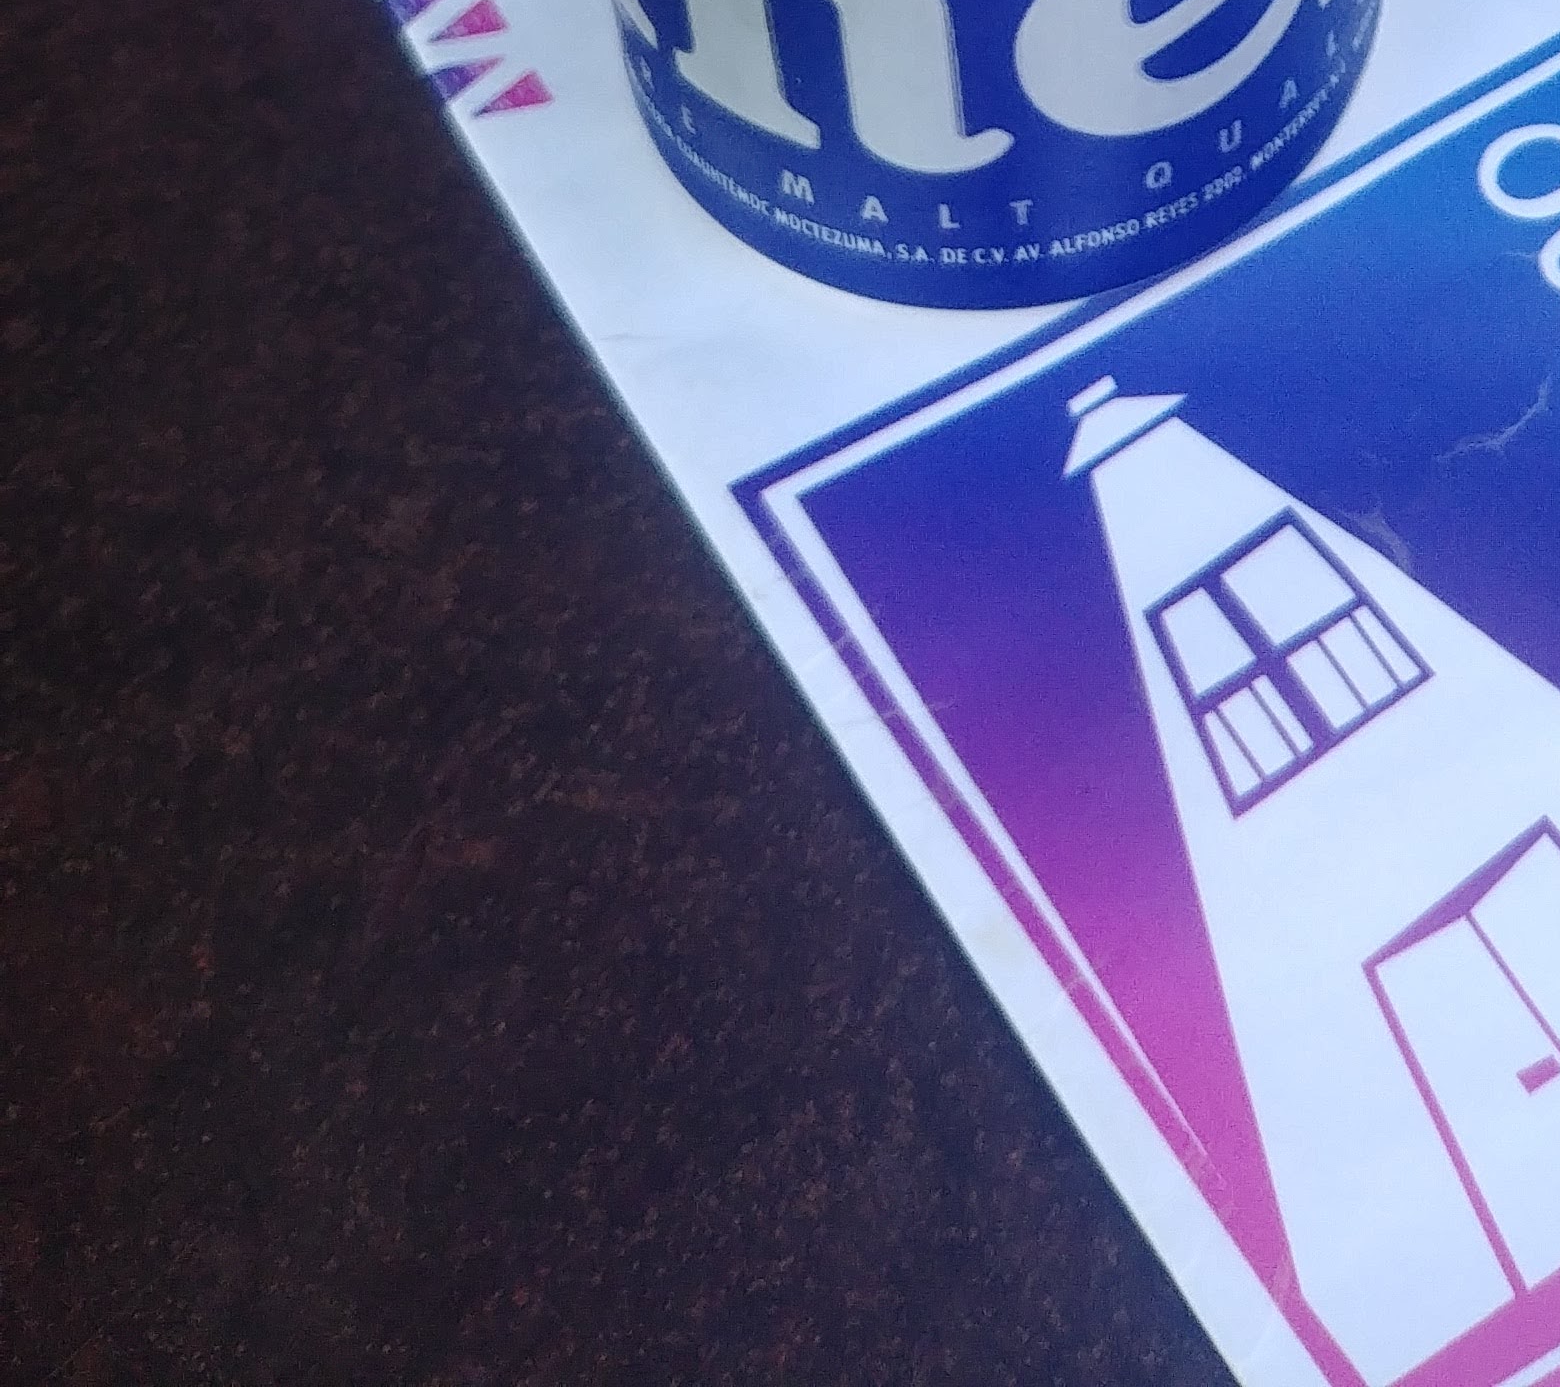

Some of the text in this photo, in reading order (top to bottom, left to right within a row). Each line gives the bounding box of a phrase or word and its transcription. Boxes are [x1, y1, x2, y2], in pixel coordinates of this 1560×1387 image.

[779, 167, 1036, 230] MALT
[939, 246, 969, 265] DE
[1049, 217, 1141, 258] ALFONSO
[1144, 190, 1200, 230] REYES
